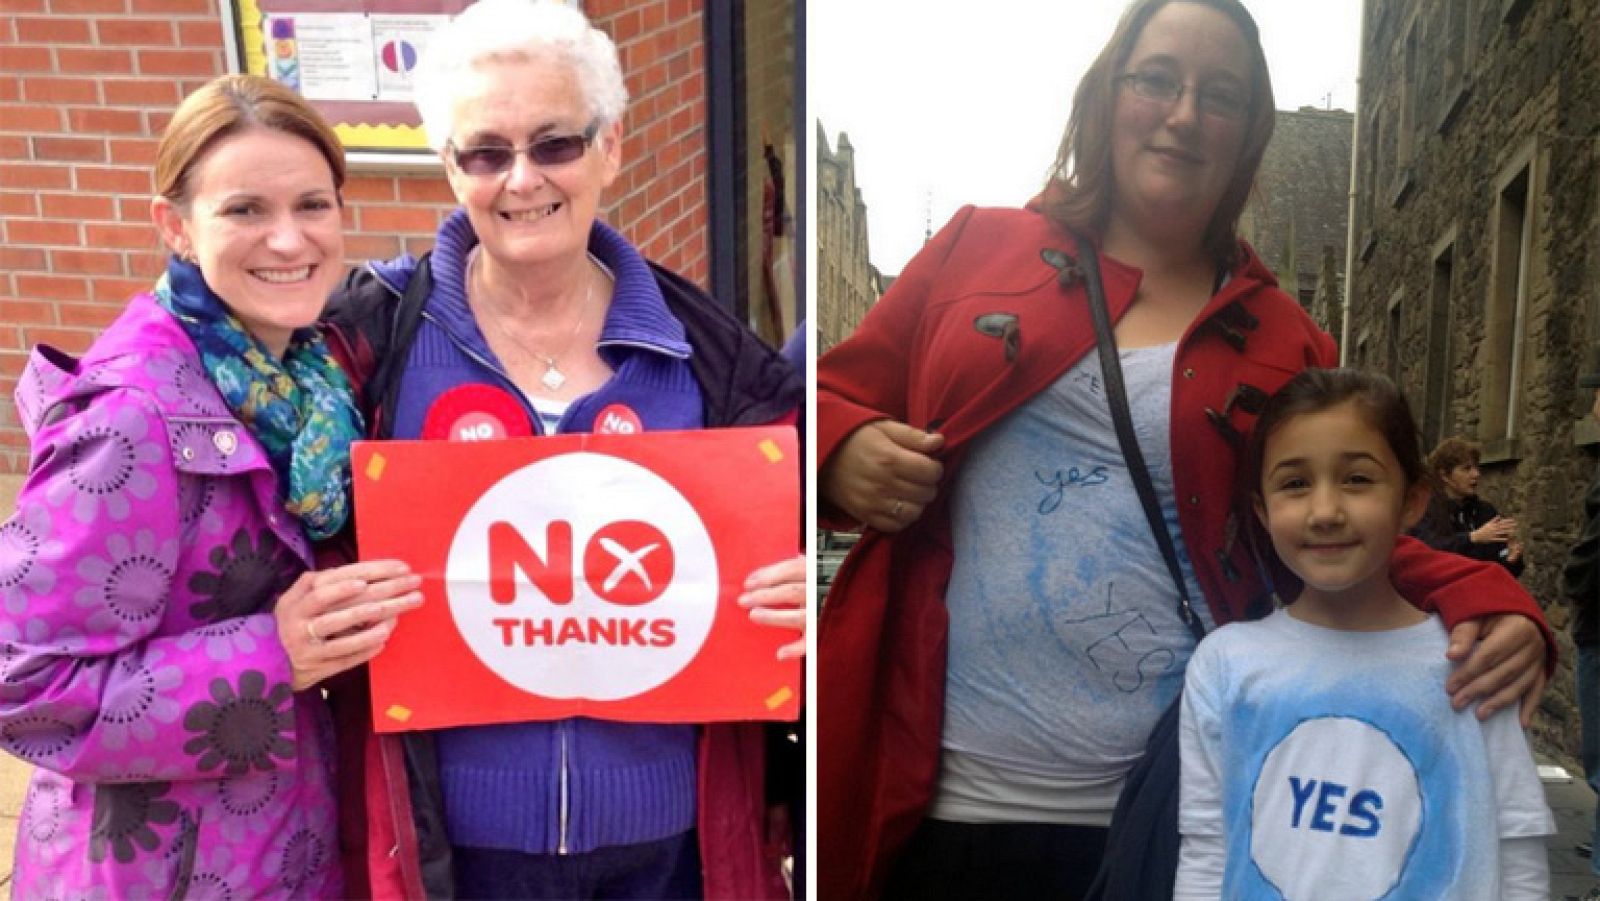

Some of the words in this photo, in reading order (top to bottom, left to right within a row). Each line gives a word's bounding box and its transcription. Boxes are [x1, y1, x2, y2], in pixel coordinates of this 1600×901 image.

[460, 422, 493, 440] NO
[603, 412, 634, 433] NO
[1034, 465, 1110, 516] yes
[488, 520, 675, 606] NO
[493, 617, 676, 647] THANKS
[1066, 581, 1176, 694] YES
[1288, 776, 1384, 837] YES
